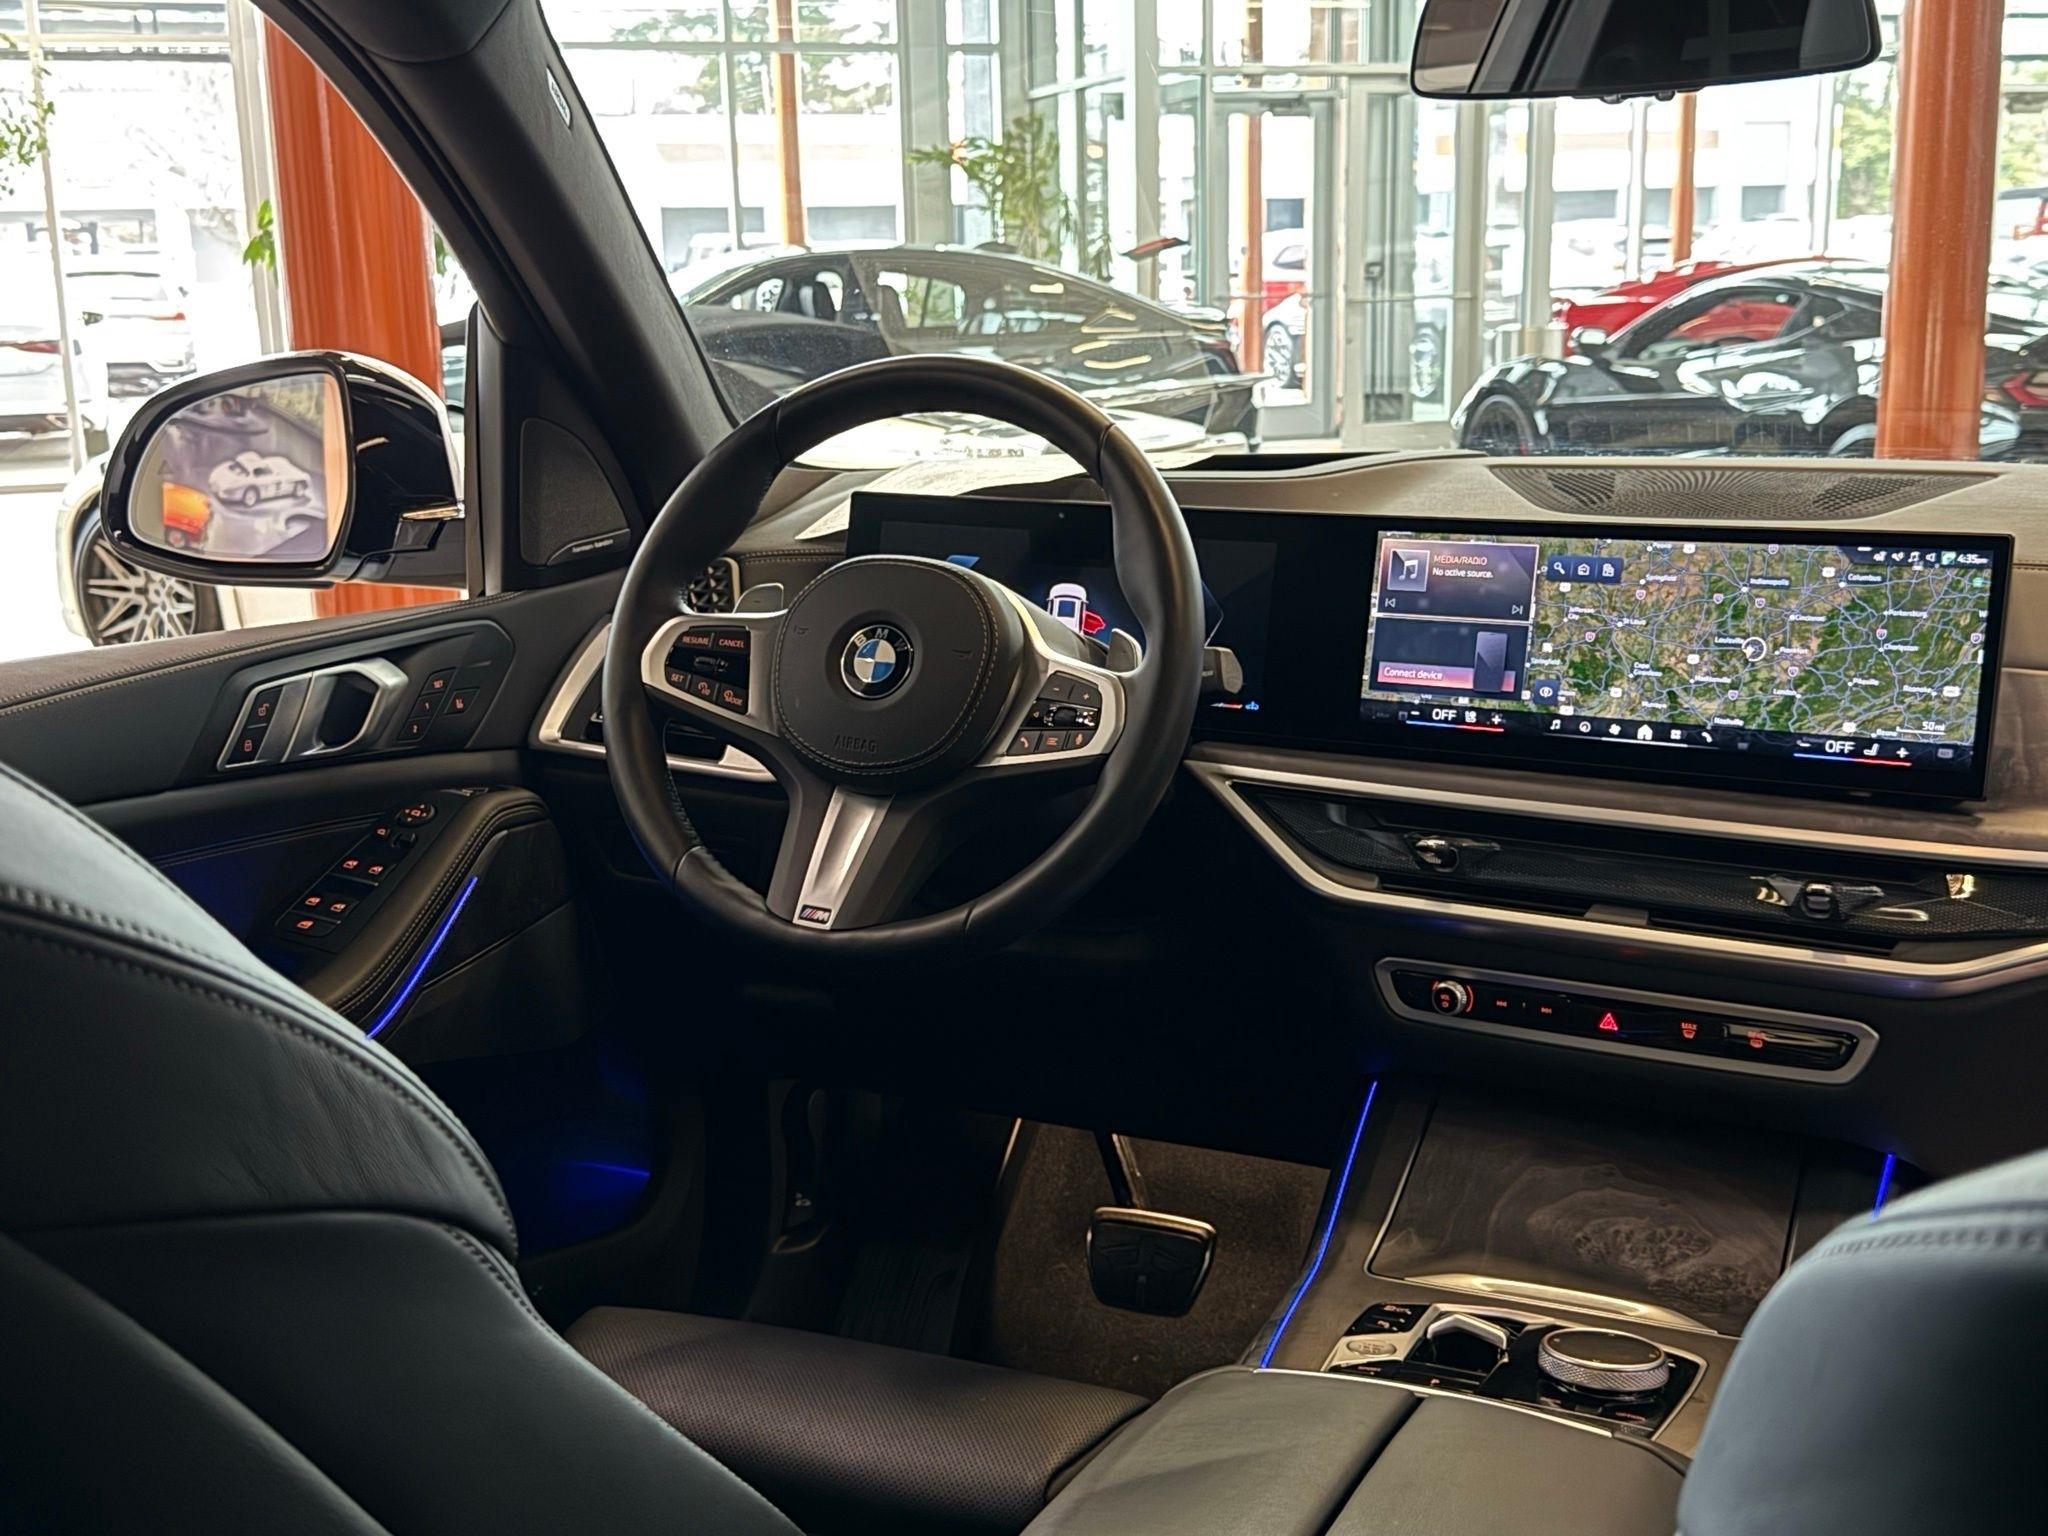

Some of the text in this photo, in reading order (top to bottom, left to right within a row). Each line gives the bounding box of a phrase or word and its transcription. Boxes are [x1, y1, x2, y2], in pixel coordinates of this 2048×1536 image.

[1433, 555, 1488, 567] MEDIA/RADIO
[1432, 567, 1494, 579] No active source.
[682, 636, 745, 649] RESUME CANCEL
[853, 627, 909, 652] BMW
[671, 673, 684, 683] SET
[1384, 667, 1443, 680] Connect device
[1432, 708, 1458, 721] OFF
[834, 734, 877, 754] AIRBAG
[1825, 740, 1855, 754] OFF
[1681, 1022, 1698, 1031] MAX
